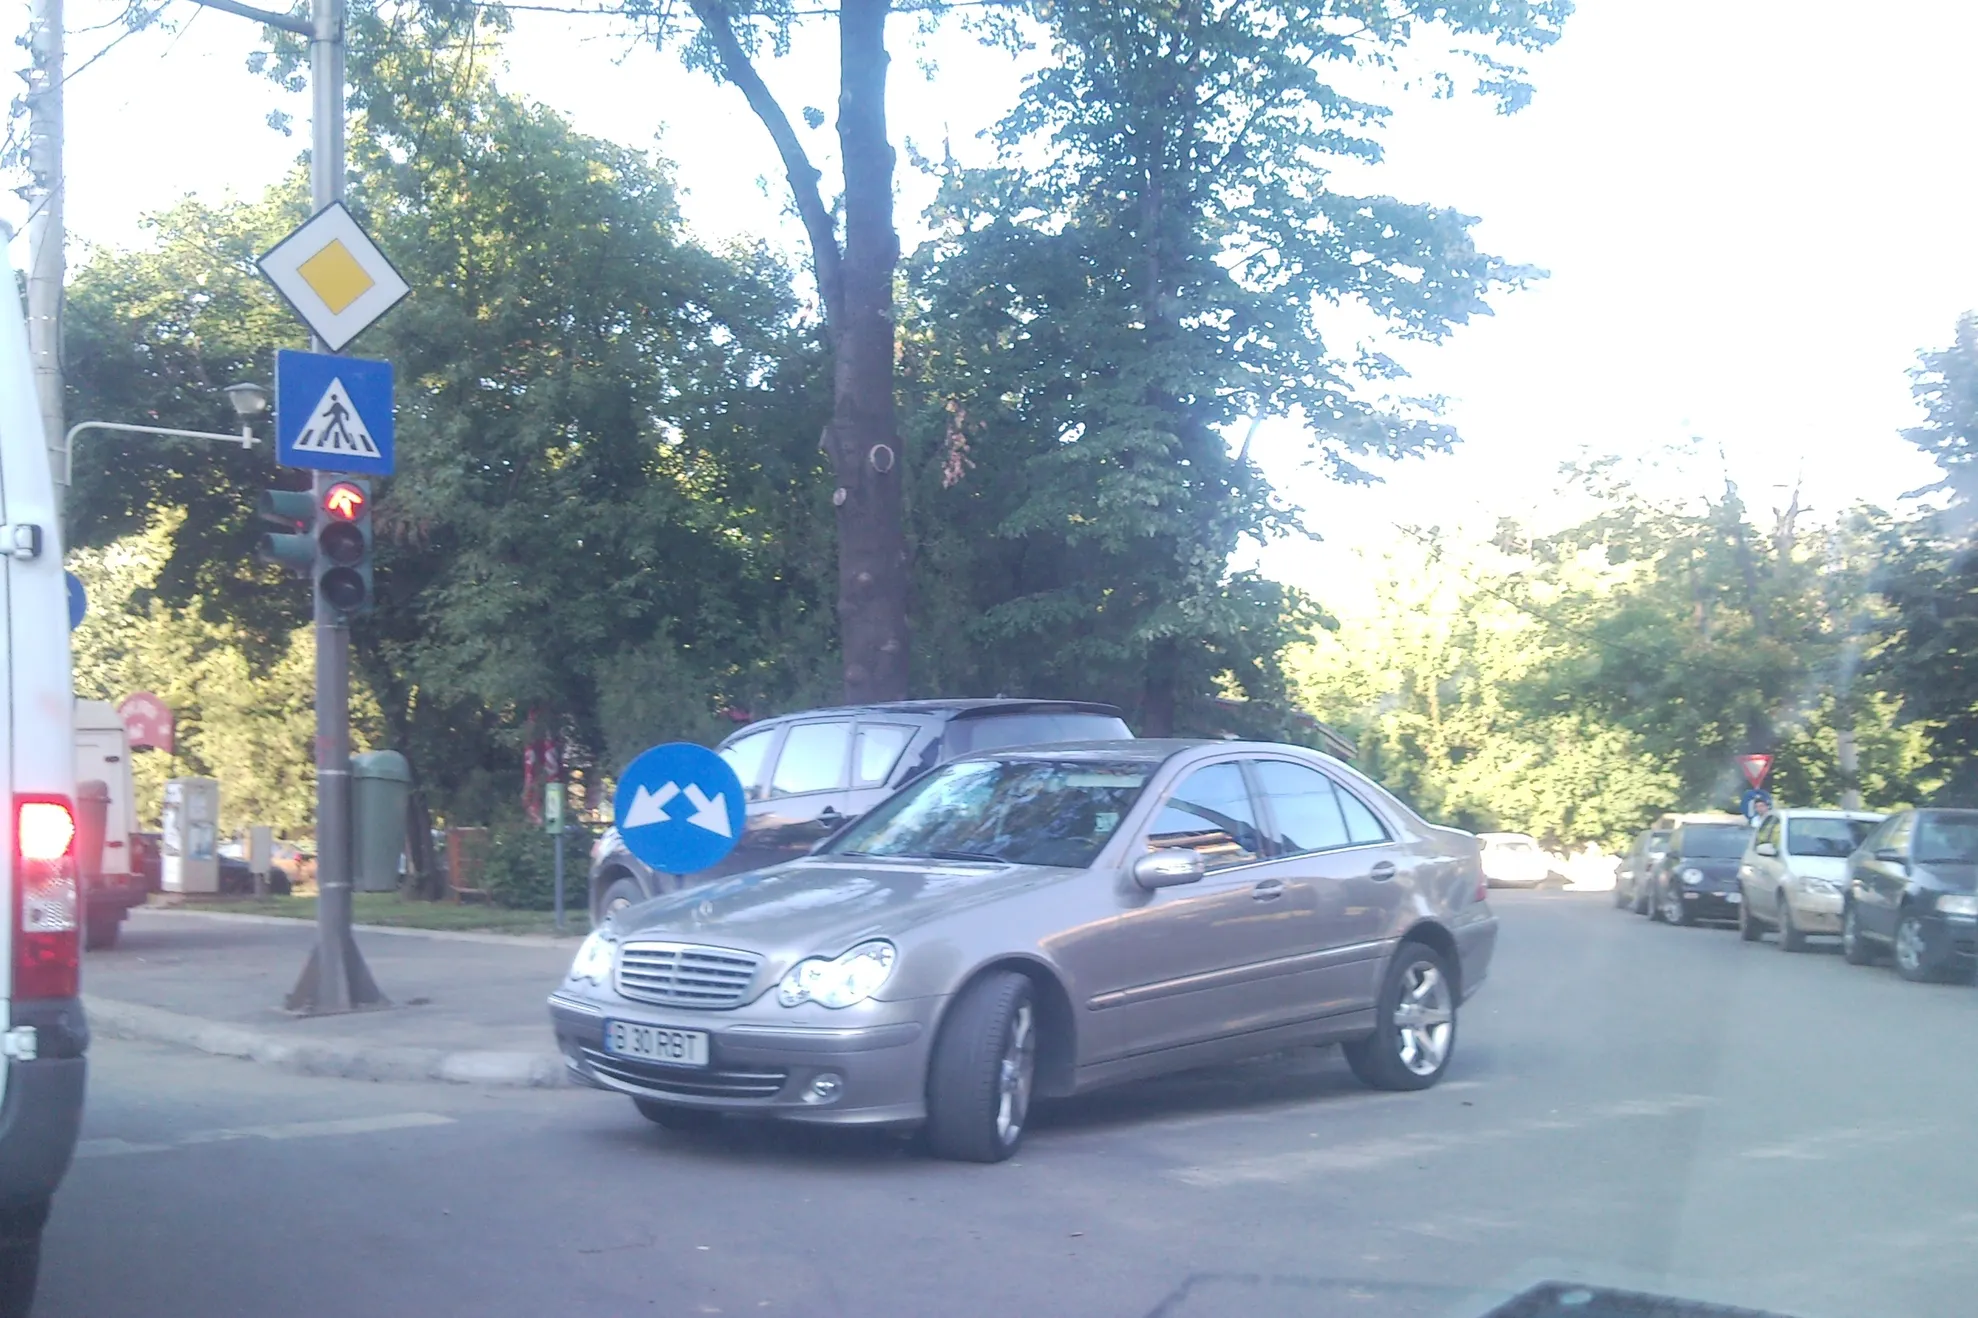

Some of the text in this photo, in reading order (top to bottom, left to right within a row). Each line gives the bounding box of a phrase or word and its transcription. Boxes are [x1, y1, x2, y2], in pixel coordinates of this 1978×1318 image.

[615, 1024, 697, 1060] B 30 RBT
